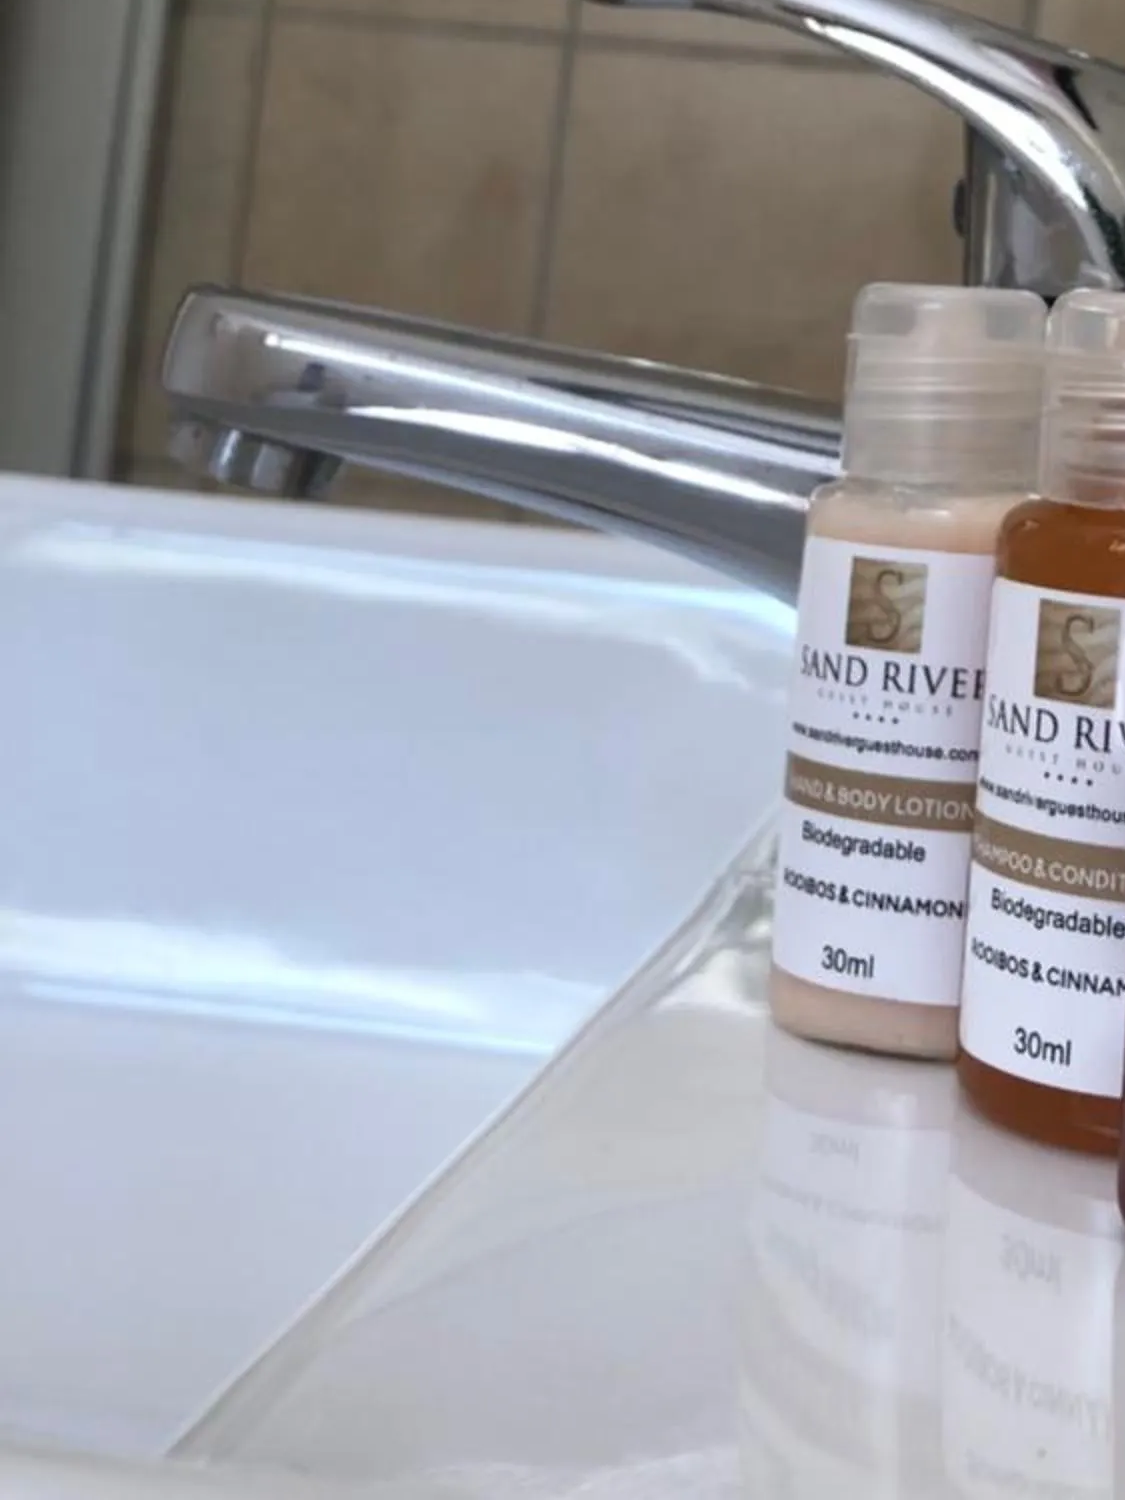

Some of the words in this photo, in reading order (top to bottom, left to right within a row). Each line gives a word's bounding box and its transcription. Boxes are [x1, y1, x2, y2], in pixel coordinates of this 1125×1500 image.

[866, 568, 903, 645] S
[800, 644, 868, 687] SAND
[1057, 613, 1095, 698] S
[987, 693, 1059, 743] SAND
[837, 787, 892, 812] BODY
[895, 794, 975, 820] LOTION
[802, 820, 926, 863] Biodegradable
[852, 889, 964, 919] CINNAMON
[821, 945, 875, 979] 30ml
[1014, 1026, 1072, 1066] 30ml
